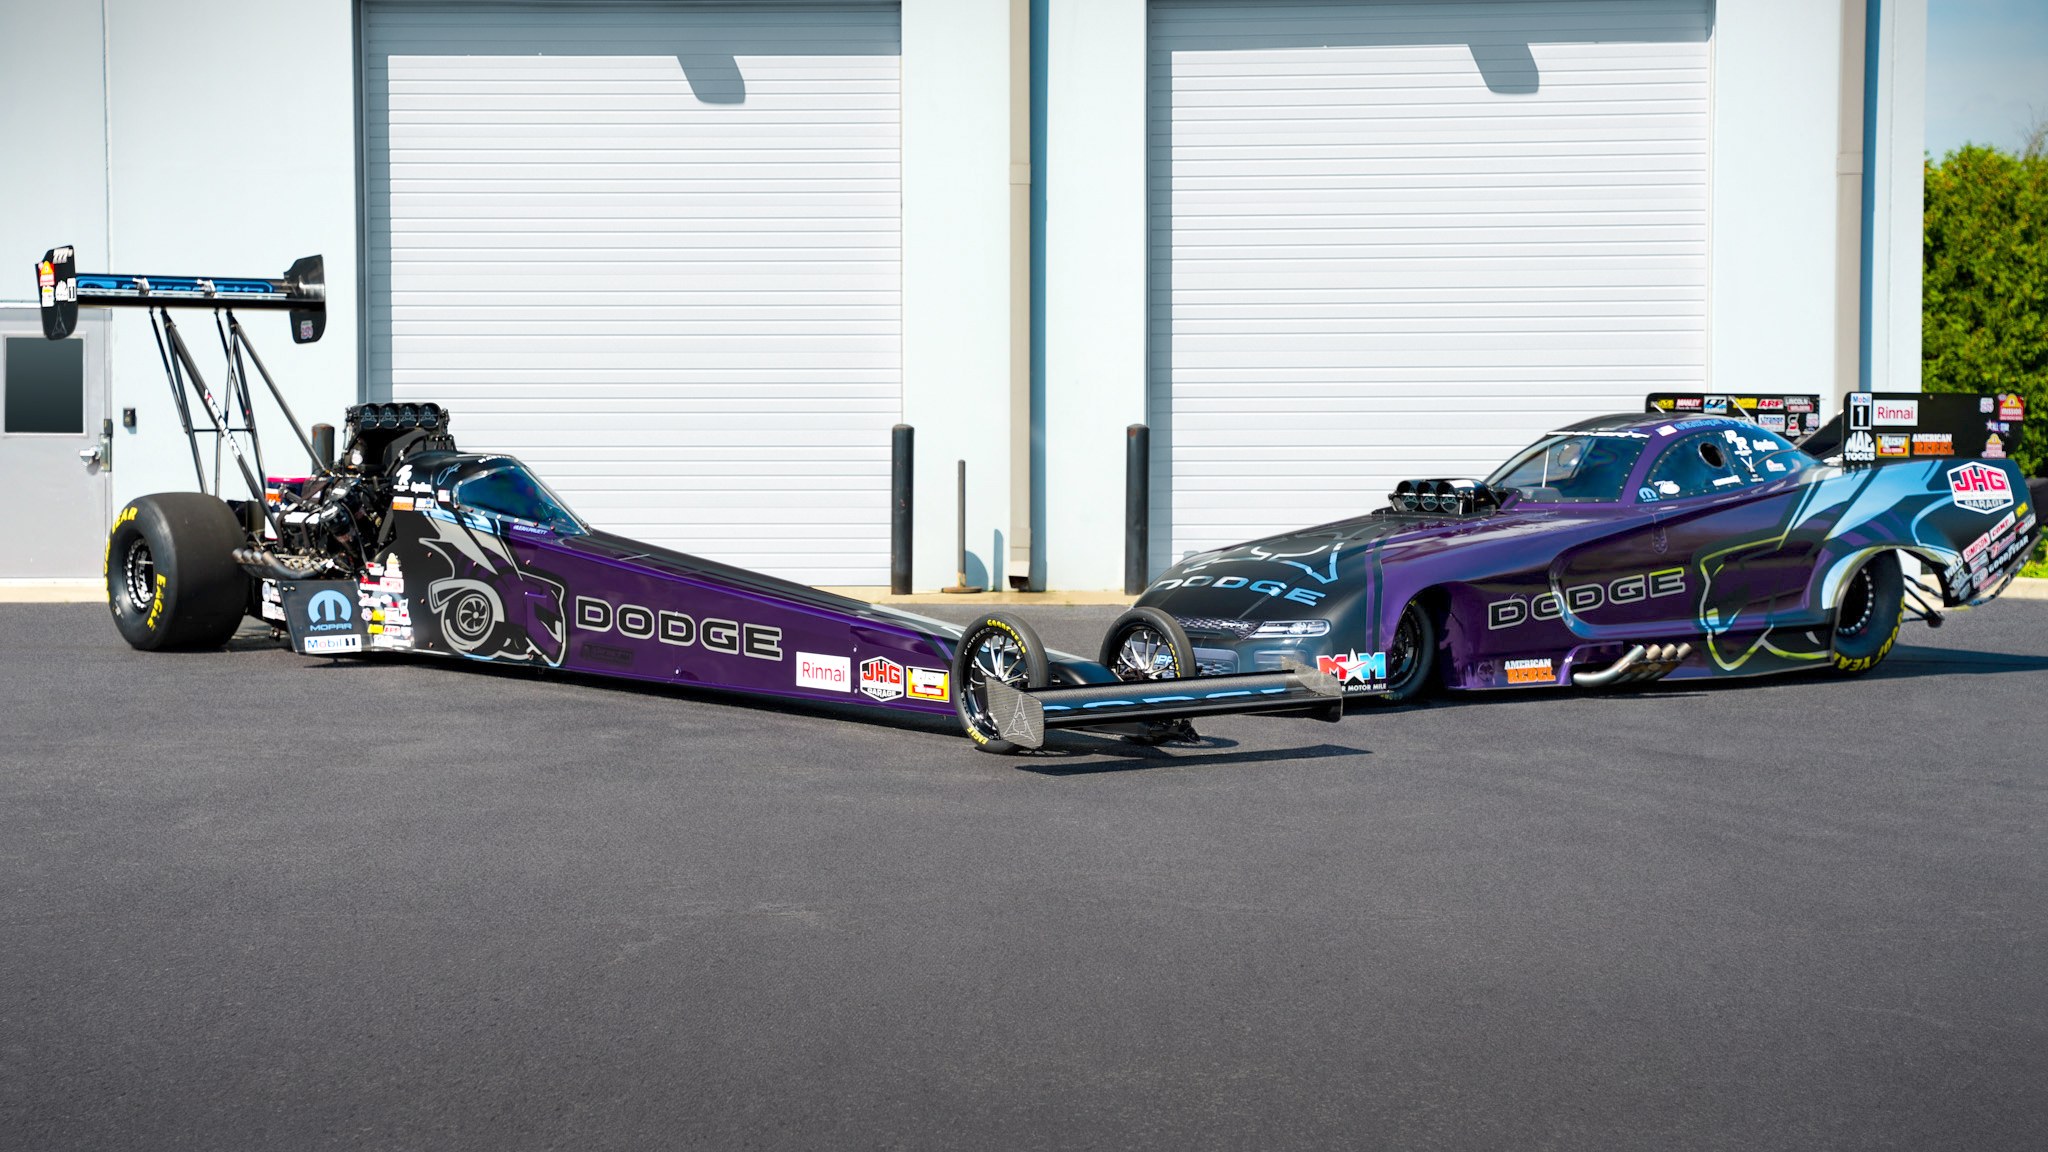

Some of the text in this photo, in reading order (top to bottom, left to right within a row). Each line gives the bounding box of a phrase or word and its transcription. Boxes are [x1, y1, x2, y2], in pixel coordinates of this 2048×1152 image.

[1760, 399, 1783, 407] ARP
[1853, 395, 1870, 403] Mobil
[1877, 406, 1914, 419] Rinnai
[1845, 431, 1875, 452] MAG
[1912, 434, 1952, 443] AMERICAN
[1914, 442, 1955, 455] REBEL
[1845, 453, 1875, 461] TOOLS
[1954, 468, 2007, 490] JHG
[1965, 499, 2004, 509] GARAGE
[1965, 536, 1988, 559] SIMPSON
[1988, 535, 2029, 573] GOODYEAR
[1153, 575, 1327, 607] DODGE
[1488, 567, 1686, 630] DODGE
[309, 623, 352, 632] MOPAR
[576, 595, 783, 661] DODGE
[987, 618, 1027, 654] GOODYEAR
[307, 639, 342, 649] Mobil
[1504, 658, 1552, 670] AMERICAN
[802, 661, 846, 683] Rinnai
[862, 661, 901, 684] JHG
[1507, 667, 1556, 684] REBEL
[867, 687, 896, 698] GARAGE
[1347, 683, 1372, 692] MOTOR
[967, 727, 989, 745] EAGLE
